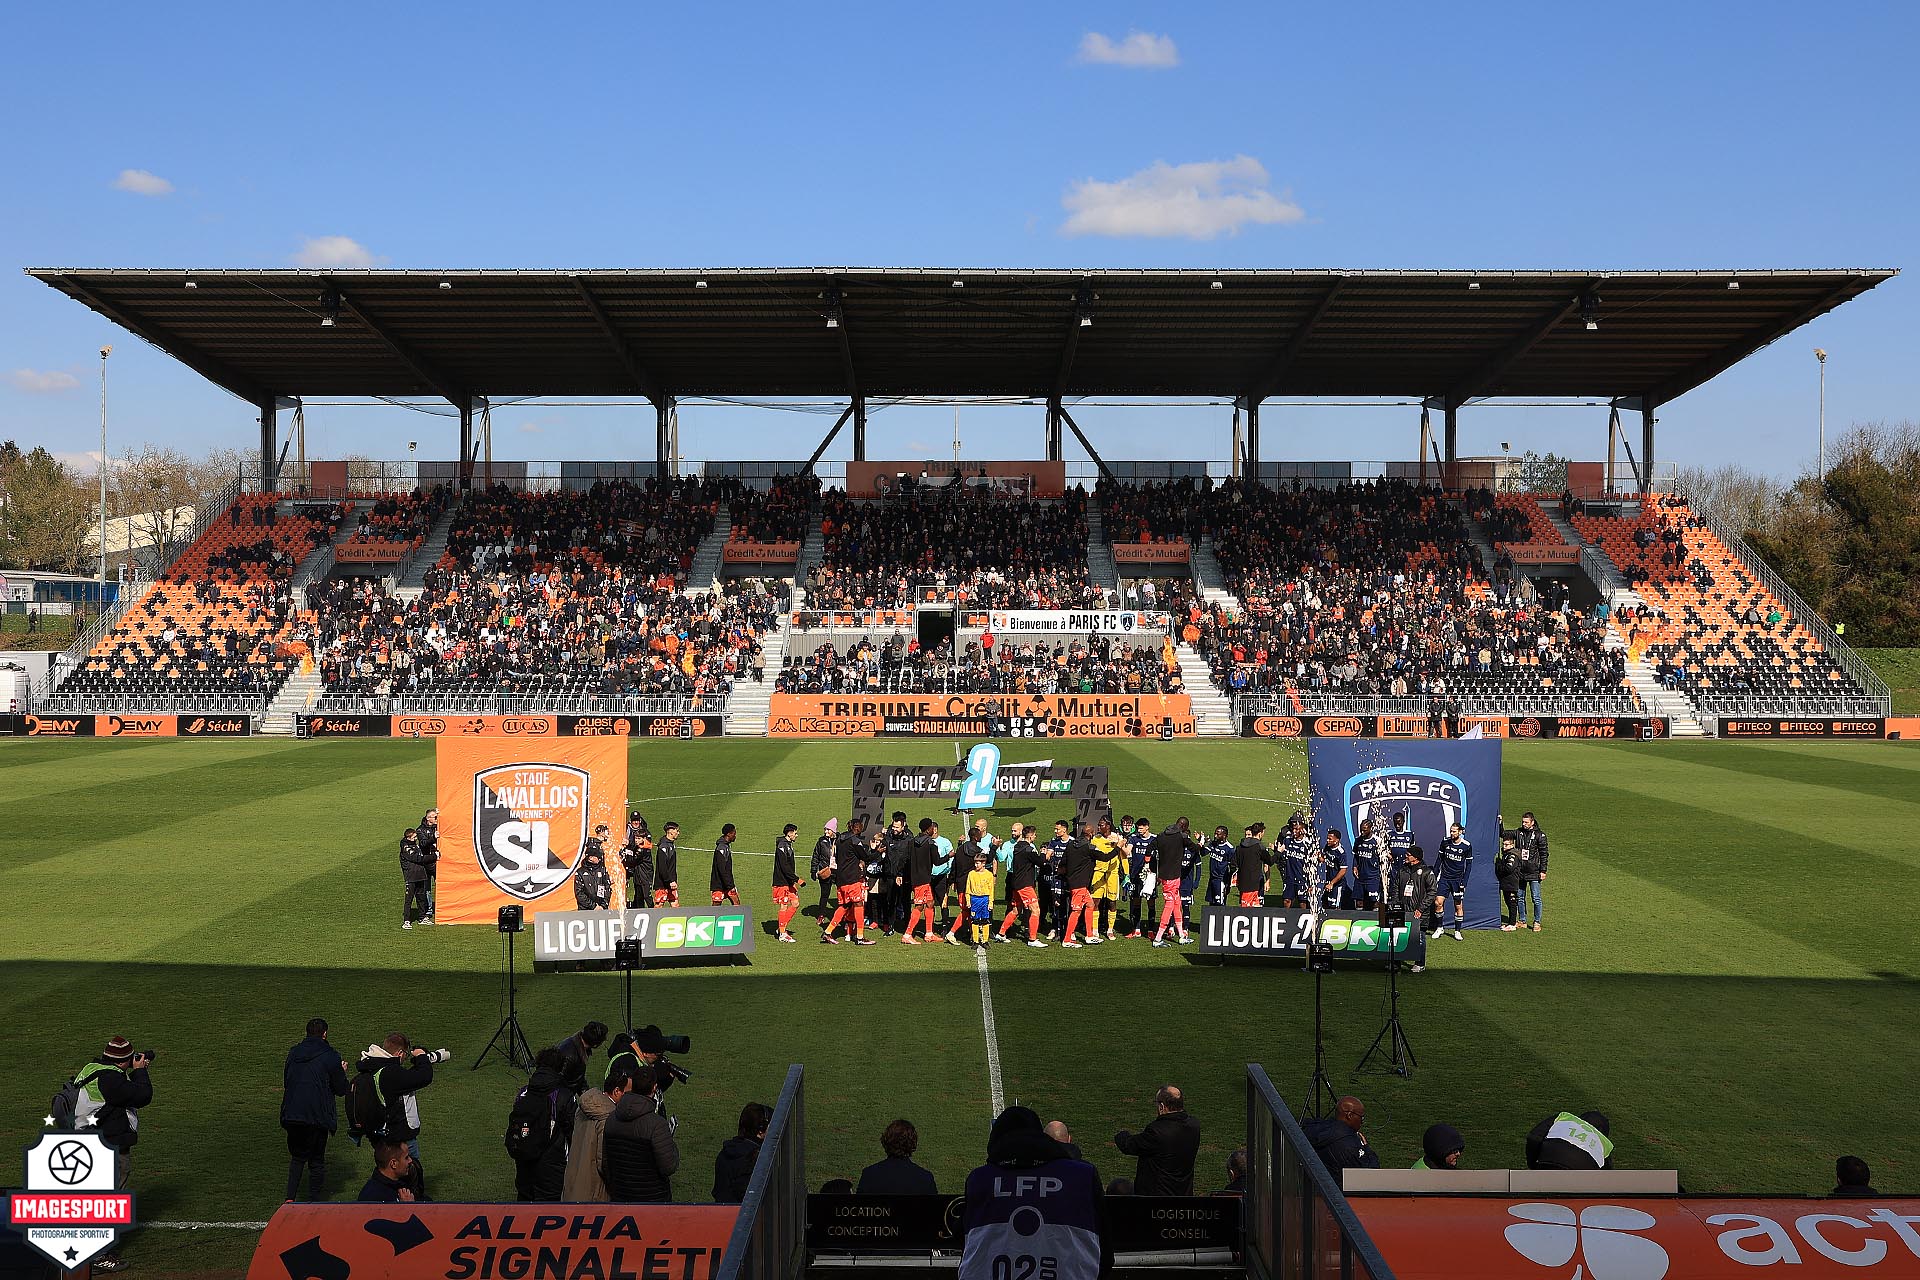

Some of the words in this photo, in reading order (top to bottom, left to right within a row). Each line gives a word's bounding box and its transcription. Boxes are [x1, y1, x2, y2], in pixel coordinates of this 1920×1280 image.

[337, 548, 364, 558] Crédit
[377, 549, 407, 558] Mutue
[726, 548, 754, 558] Crédit
[767, 549, 798, 558] Mutuel
[1115, 548, 1143, 558] Crédit
[1156, 549, 1187, 558] Mutuel
[1547, 549, 1578, 559] Mutuel
[1010, 617, 1058, 630] Bienvenue
[1060, 617, 1066, 630] à
[1068, 614, 1100, 630] PARIS
[1103, 614, 1117, 630] FC
[1057, 697, 1140, 717] Mutuel
[25, 714, 81, 735] DEMY
[108, 714, 164, 735] DEMY
[206, 719, 242, 732] Séché
[325, 719, 360, 732] Séché
[403, 721, 442, 732] LUCAS
[507, 721, 545, 732] LUCAS
[578, 716, 613, 727] ouest
[653, 718, 686, 727] oues
[800, 717, 877, 735] Kappa
[1069, 720, 1121, 735] actual
[1145, 718, 1196, 735] acual
[1323, 720, 1359, 732] SEPAL
[1383, 717, 1391, 732] le
[1394, 717, 1430, 732] Courrie
[1737, 722, 1772, 731] FITECO
[1789, 722, 1824, 731] FITECO
[1842, 722, 1877, 731] FITECO
[648, 724, 681, 736] franc
[1557, 726, 1616, 738] MOMENTS
[514, 771, 550, 785] STADE
[888, 774, 926, 792] LIGUE
[927, 773, 939, 792] 2
[1026, 774, 1039, 792] 2
[1040, 779, 1072, 792] BKT
[1359, 779, 1420, 799] PARIS
[1427, 781, 1453, 800] FC
[484, 785, 580, 809] LAVALLOIS
[509, 809, 543, 819] MAYENNE
[544, 809, 554, 819] FC
[525, 863, 541, 871] 1902
[543, 917, 622, 954] LIGUE
[657, 917, 743, 946] BKT
[1207, 913, 1287, 950] LIGUE
[1321, 920, 1409, 950] BKT
[1568, 1127, 1588, 1143] 14
[993, 1176, 1063, 1198] LFP
[835, 1206, 891, 1218] LOCATION
[1151, 1209, 1221, 1221] LOGISTIQUE
[453, 1215, 643, 1241] ALPHA
[827, 1225, 899, 1237] CONCEPTION
[1160, 1228, 1211, 1239] CONSEIL
